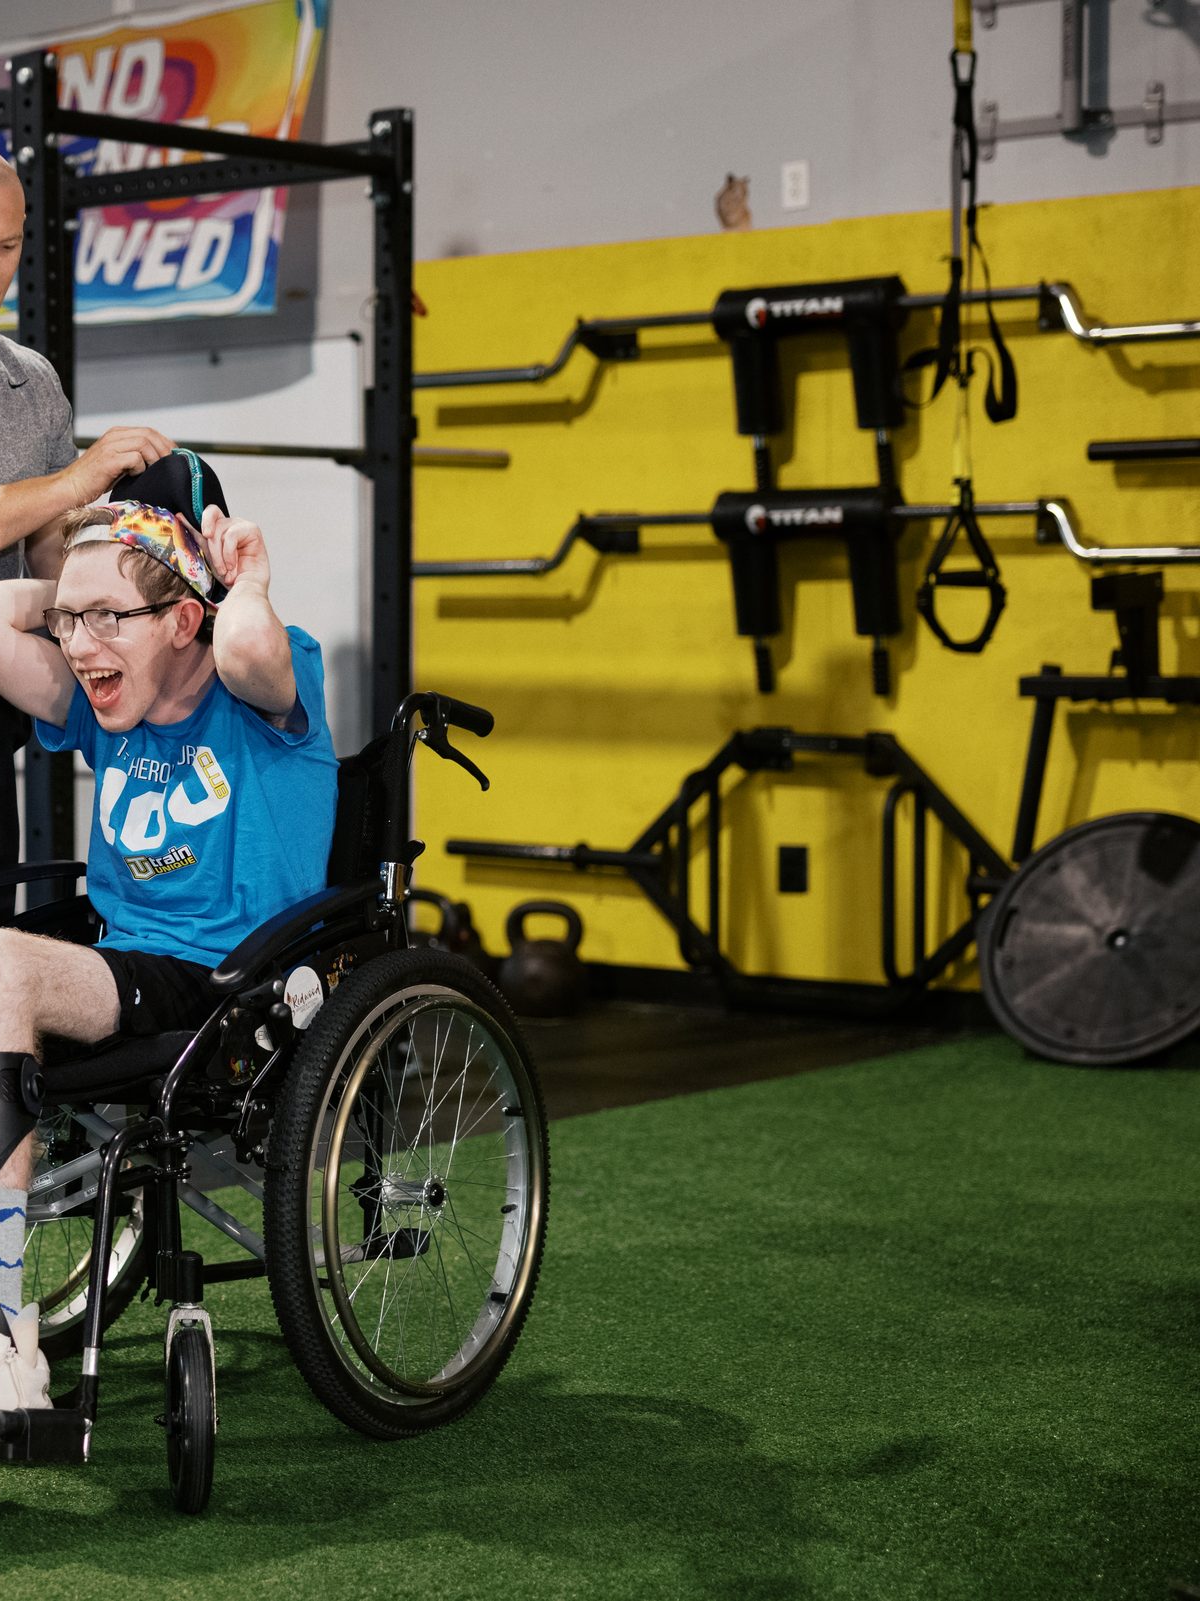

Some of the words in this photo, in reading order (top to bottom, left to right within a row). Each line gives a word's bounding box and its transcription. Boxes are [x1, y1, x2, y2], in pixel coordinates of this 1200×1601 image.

[60, 38, 164, 115] NO
[74, 210, 234, 291] WED
[769, 296, 844, 318] TITAN
[768, 505, 843, 527] TITAN
[197, 751, 230, 799] CLUB
[154, 856, 196, 874] UNIQUE
